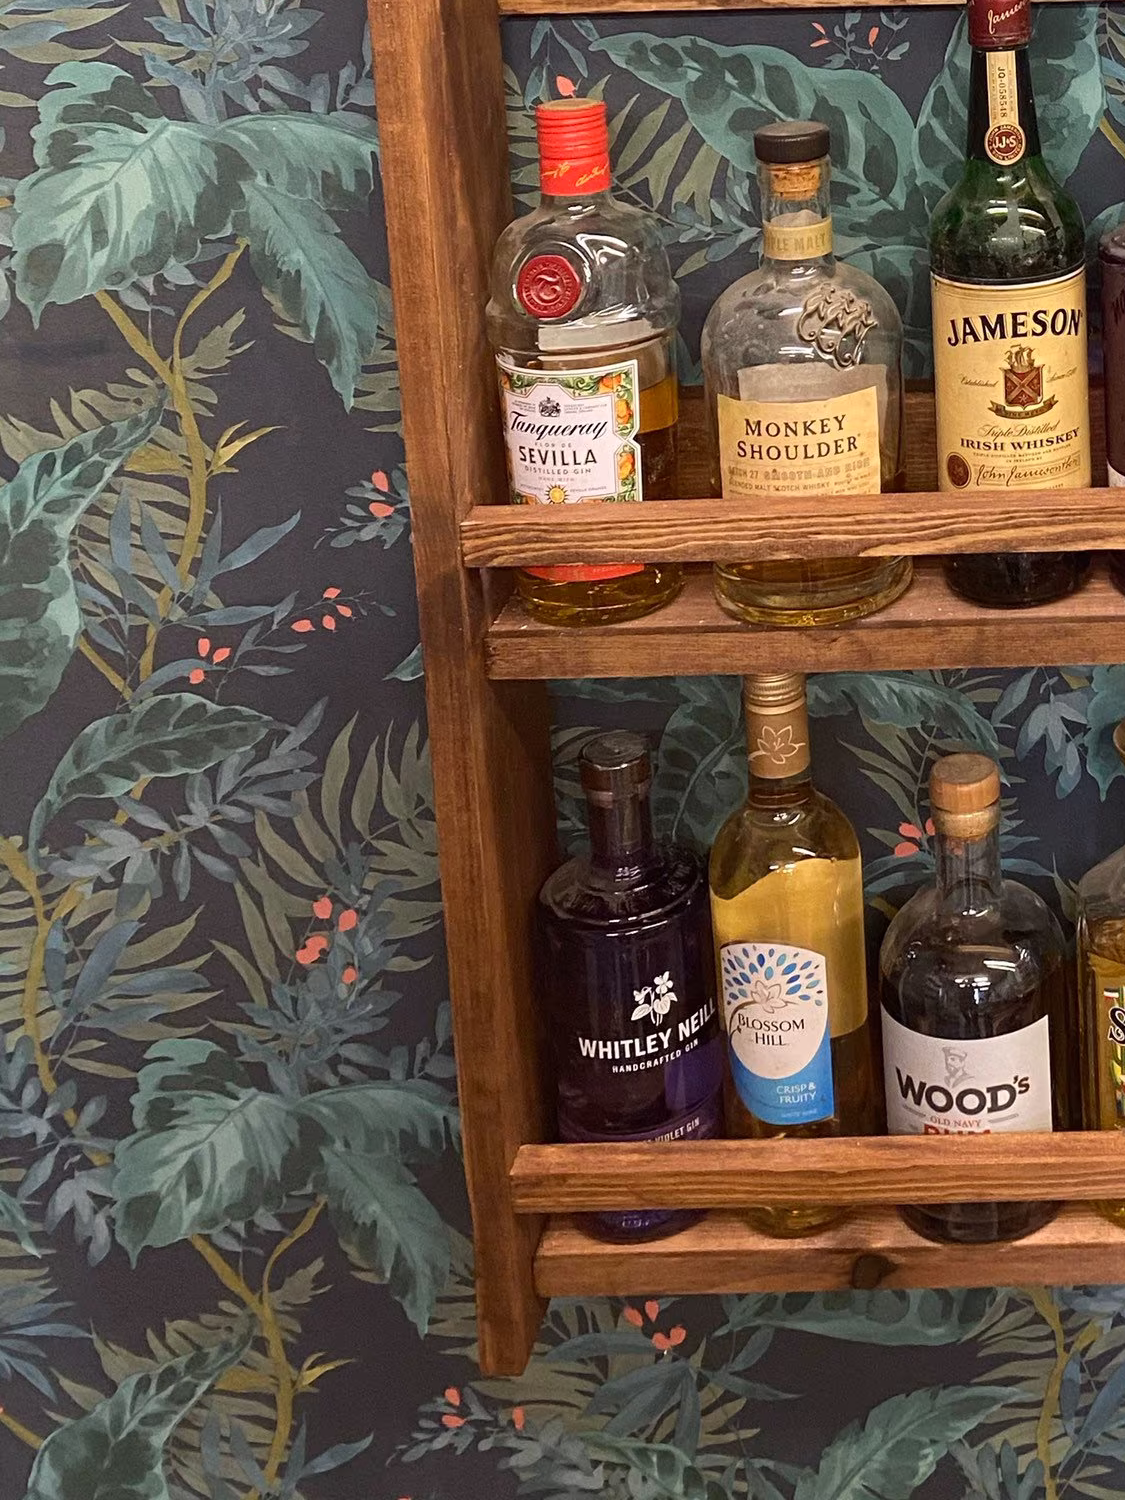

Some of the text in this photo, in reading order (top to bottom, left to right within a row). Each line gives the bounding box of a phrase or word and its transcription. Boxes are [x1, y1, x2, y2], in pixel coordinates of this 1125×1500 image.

[793, 232, 826, 251] MALT
[947, 308, 1081, 347] JAMESON
[510, 411, 608, 440] Tanqueray
[744, 414, 846, 437] MONKEY
[978, 420, 1061, 442] Triple Distilled
[737, 435, 858, 460] SHOULDER
[960, 427, 1080, 451] IRISH WHISKEY
[519, 445, 597, 466] SEVILLA
[525, 465, 569, 475] DISTILLED
[749, 470, 759, 479] 27
[976, 464, 1006, 486] John
[754, 484, 771, 492] MALT
[773, 484, 800, 492] SCOTCH
[802, 481, 831, 491] WHISKY
[578, 997, 716, 1059] WHITLEY NEILL
[738, 1013, 805, 1032] BLOSSOM
[755, 1032, 787, 1046] HILL
[612, 1037, 699, 1073] HANDCRAFTED GIN
[776, 1082, 816, 1094] CRISP &
[779, 1091, 816, 1104] FRUITY
[896, 1066, 1030, 1115] WOOD'S
[686, 1116, 700, 1132] GIN
[930, 1116, 982, 1128] OLD NAVY
